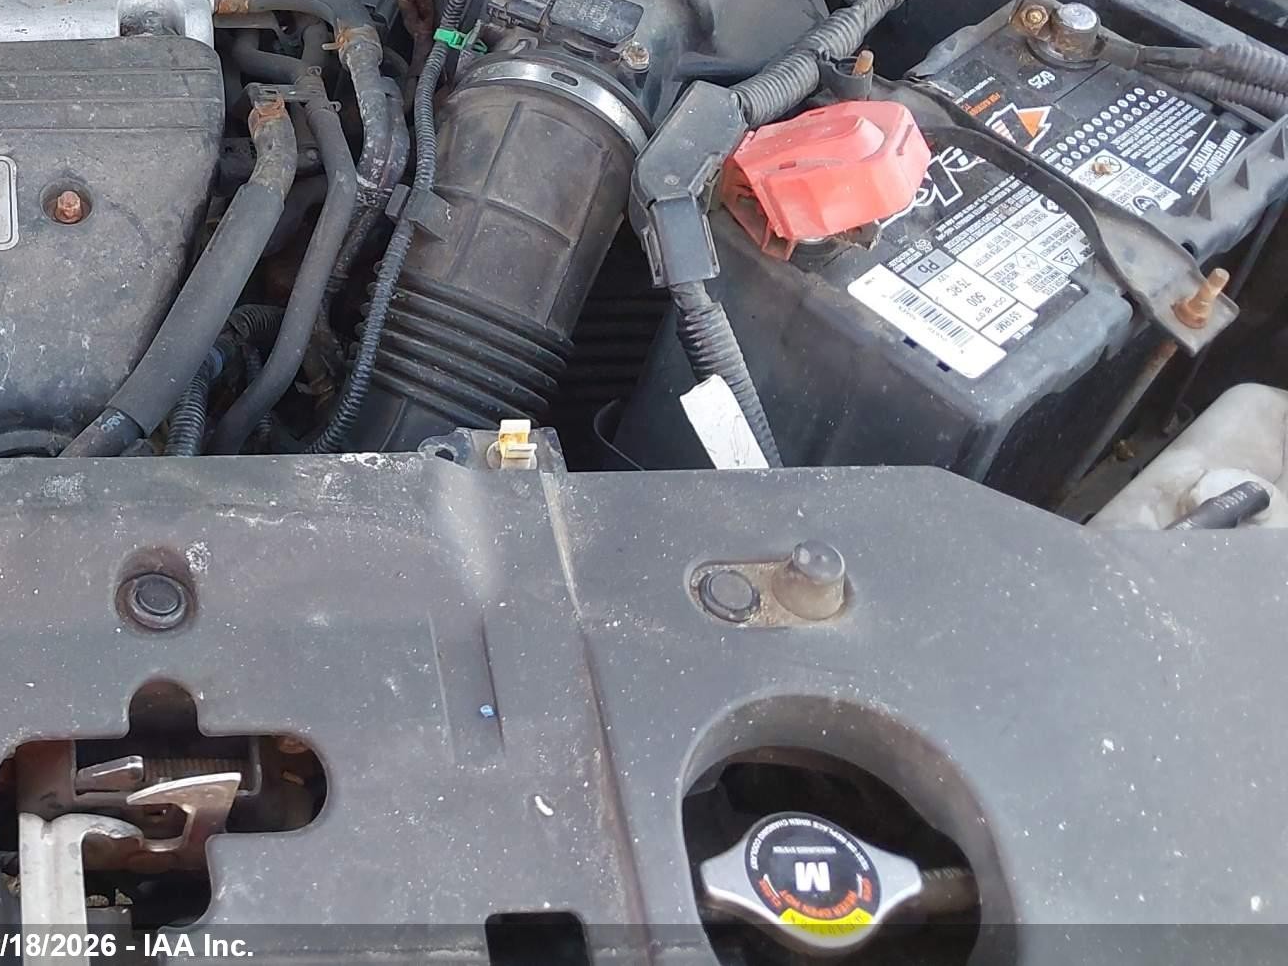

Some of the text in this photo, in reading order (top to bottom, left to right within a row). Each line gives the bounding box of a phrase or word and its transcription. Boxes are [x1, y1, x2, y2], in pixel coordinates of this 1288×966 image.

[1027, 71, 1055, 88] 6/25
[1189, 141, 1216, 171] BATTERY
[917, 259, 939, 275] Pb
[965, 291, 986, 306] 500
[788, 818, 812, 826] WHEN
[812, 821, 848, 845] REPLACE
[794, 861, 831, 892] M
